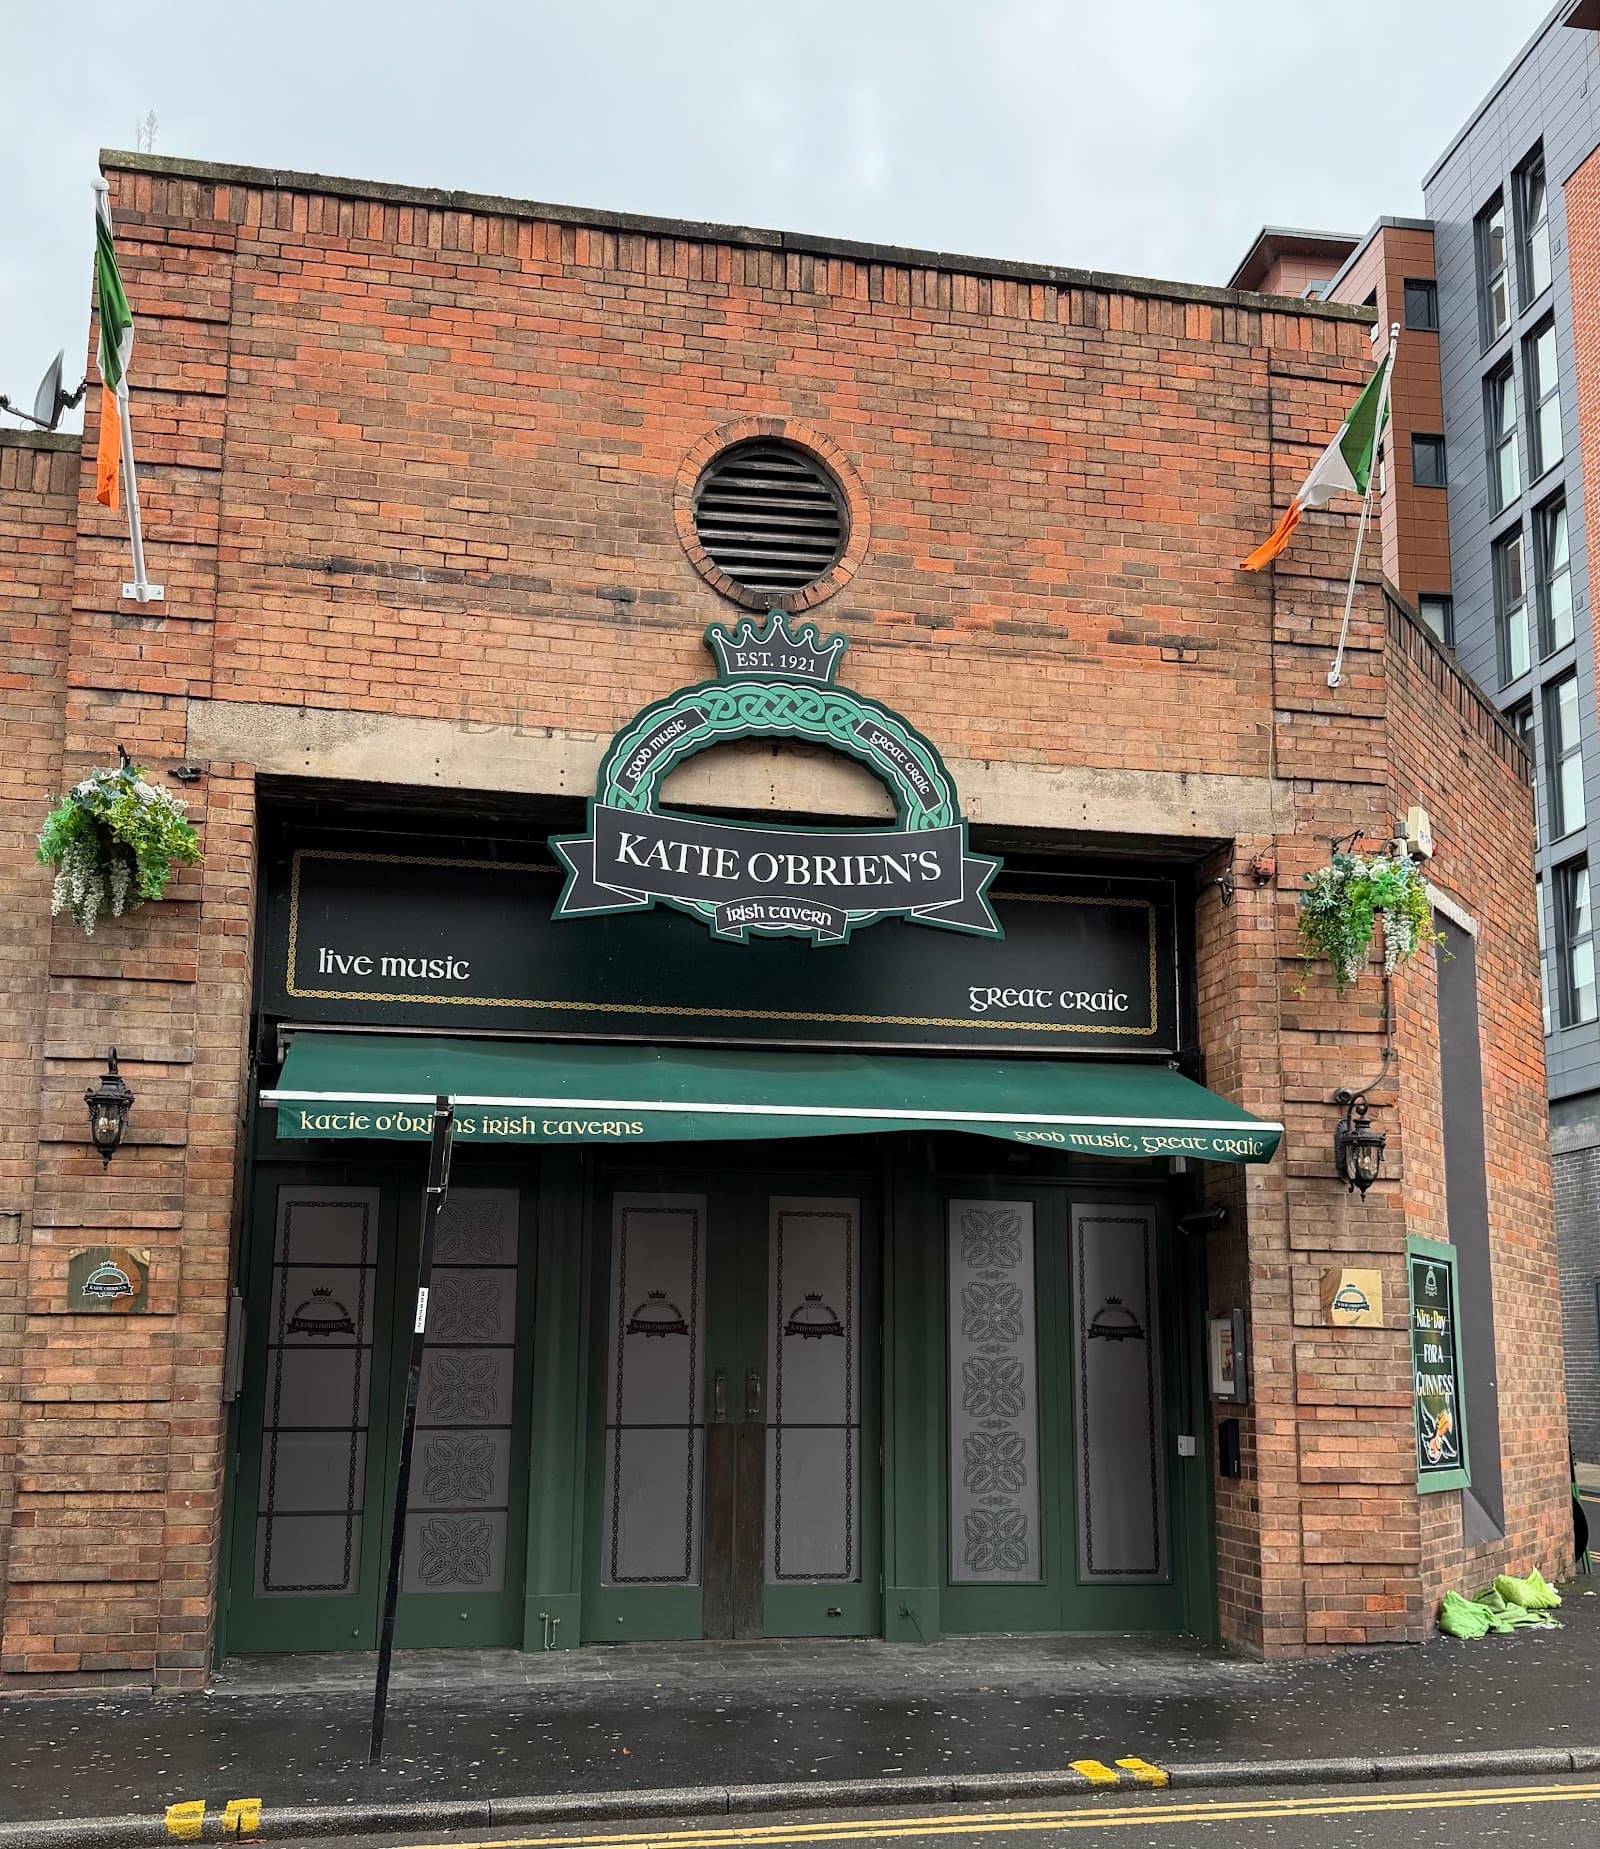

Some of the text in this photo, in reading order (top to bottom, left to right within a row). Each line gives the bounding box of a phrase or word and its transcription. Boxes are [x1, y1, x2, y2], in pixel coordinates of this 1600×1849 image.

[736, 651, 815, 673] EST. 1921
[649, 719, 687, 751] music
[615, 831, 942, 887] KATIE O'BRIEN'S
[725, 903, 832, 927] irish tavern
[318, 947, 471, 980] live music
[968, 985, 1129, 1013] great craic
[300, 1111, 644, 1137] katie o'brins irish taverns
[1069, 1132, 1138, 1152] music,
[1140, 1136, 1209, 1153] great
[1212, 1137, 1264, 1156] craic
